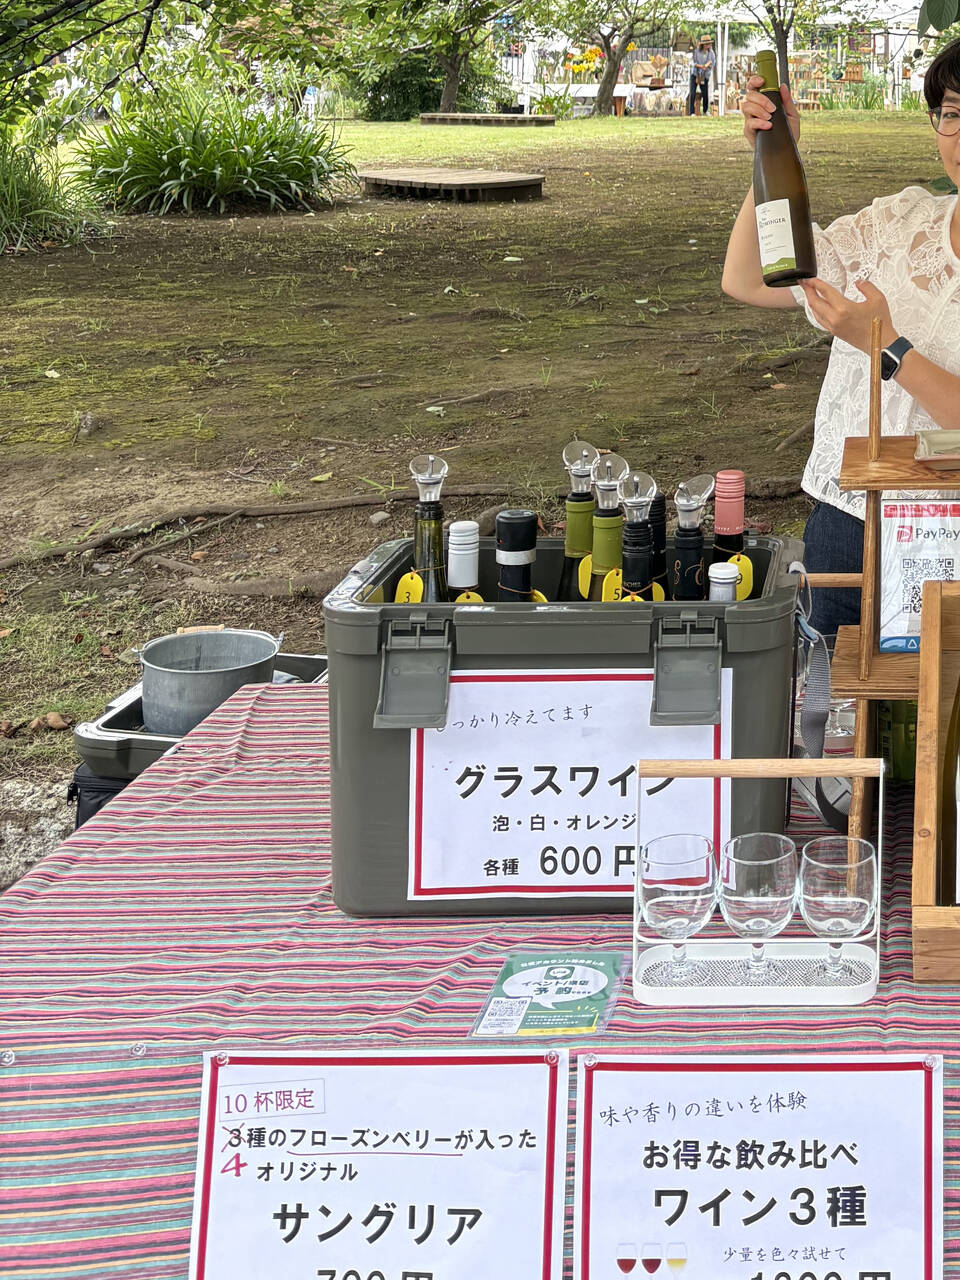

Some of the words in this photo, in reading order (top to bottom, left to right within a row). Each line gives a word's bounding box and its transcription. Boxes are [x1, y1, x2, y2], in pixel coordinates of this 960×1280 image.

[915, 527, 960, 541] PayPay
[403, 591, 411, 604] 3
[613, 588, 620, 601] 5
[437, 703, 594, 732] っかり冷えてます
[492, 813, 637, 832] 泡・白・オレンジ
[484, 858, 519, 877] 各種
[539, 844, 602, 876] 600
[599, 1090, 809, 1127] 味や香りの違いを体験
[220, 1152, 248, 1178] 4
[642, 1138, 859, 1170] お得な飲み比べ
[256, 1161, 359, 1182] オリジナル
[653, 1184, 868, 1228] ワイン3種
[272, 1202, 484, 1246] サングリア
[722, 1245, 848, 1263] 少量を色々試せて
